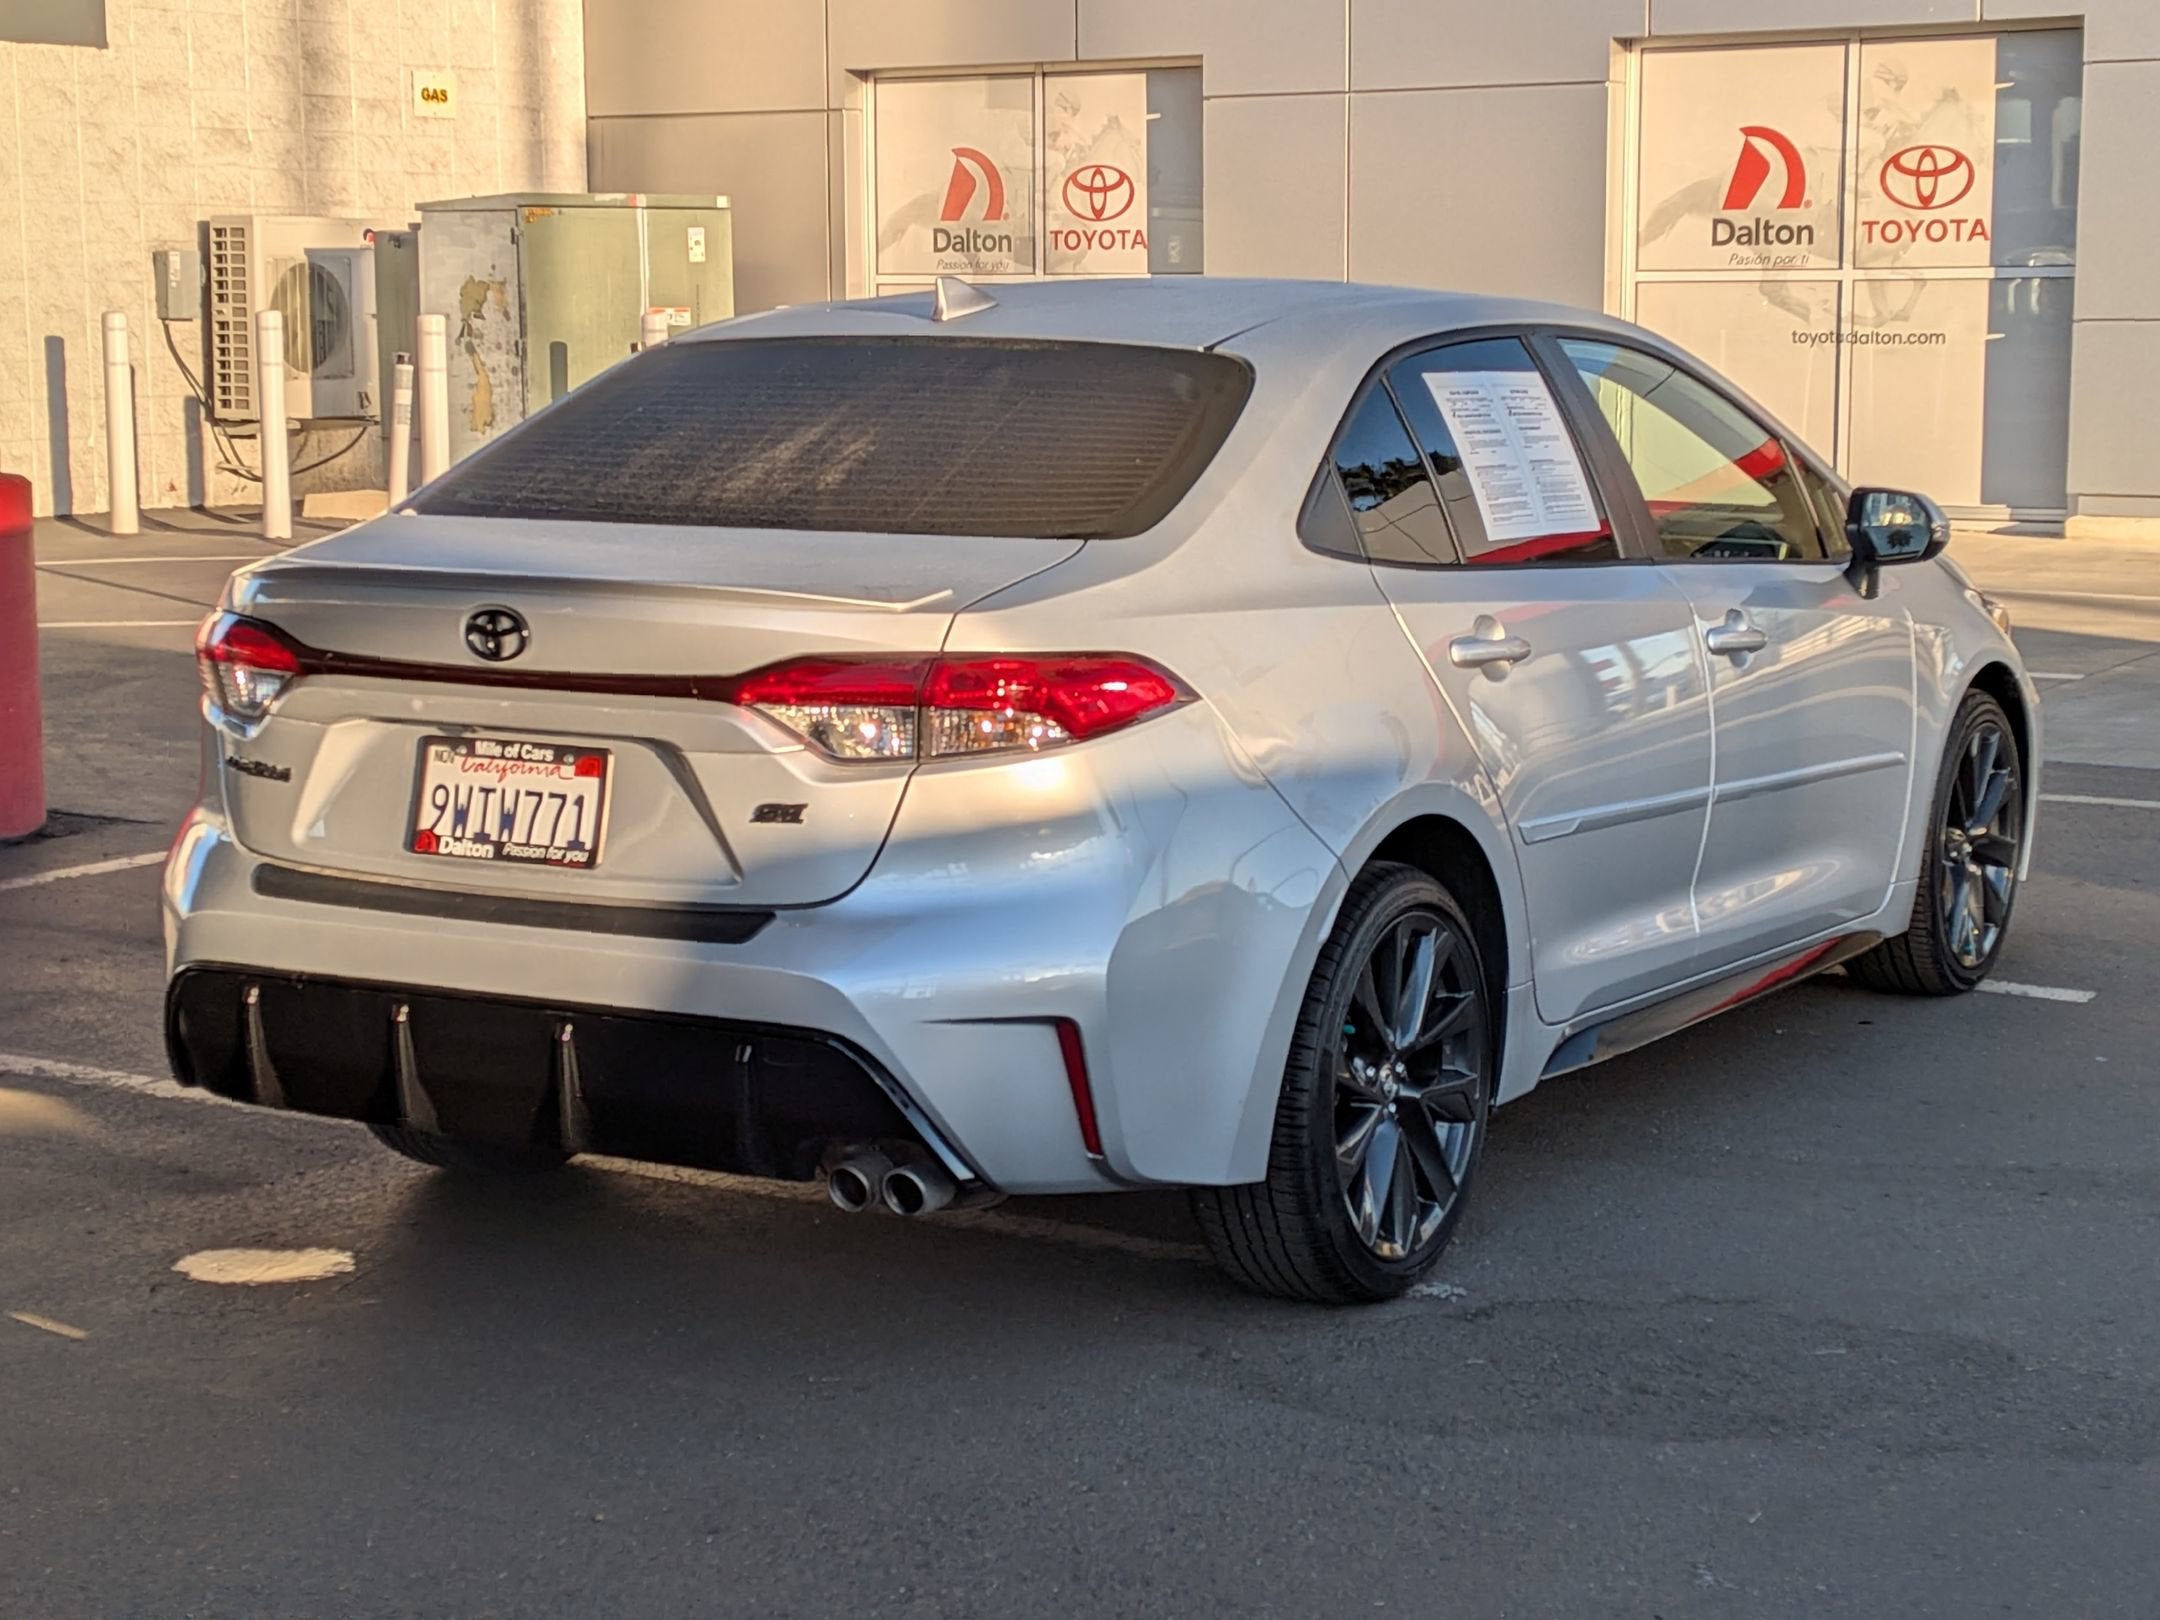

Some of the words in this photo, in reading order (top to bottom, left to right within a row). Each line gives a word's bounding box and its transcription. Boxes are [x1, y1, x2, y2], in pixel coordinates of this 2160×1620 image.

[421, 87, 448, 103] GAS
[932, 227, 1012, 254] Dalton
[1049, 229, 1148, 251] TOYOTA
[1711, 216, 1814, 246] Dalton
[1861, 218, 1990, 244] TOYOTA
[936, 258, 973, 271] Passion
[975, 258, 991, 271] for
[991, 261, 1009, 272] you
[1728, 252, 1771, 266] Pasión
[1773, 255, 1795, 268] por
[474, 740, 503, 758] Mile
[504, 743, 521, 760] of
[521, 744, 555, 762] Cars
[461, 757, 574, 783] California
[438, 837, 495, 859] Dalton
[502, 842, 546, 860] Passion
[546, 847, 564, 861] for
[564, 850, 590, 863] you
